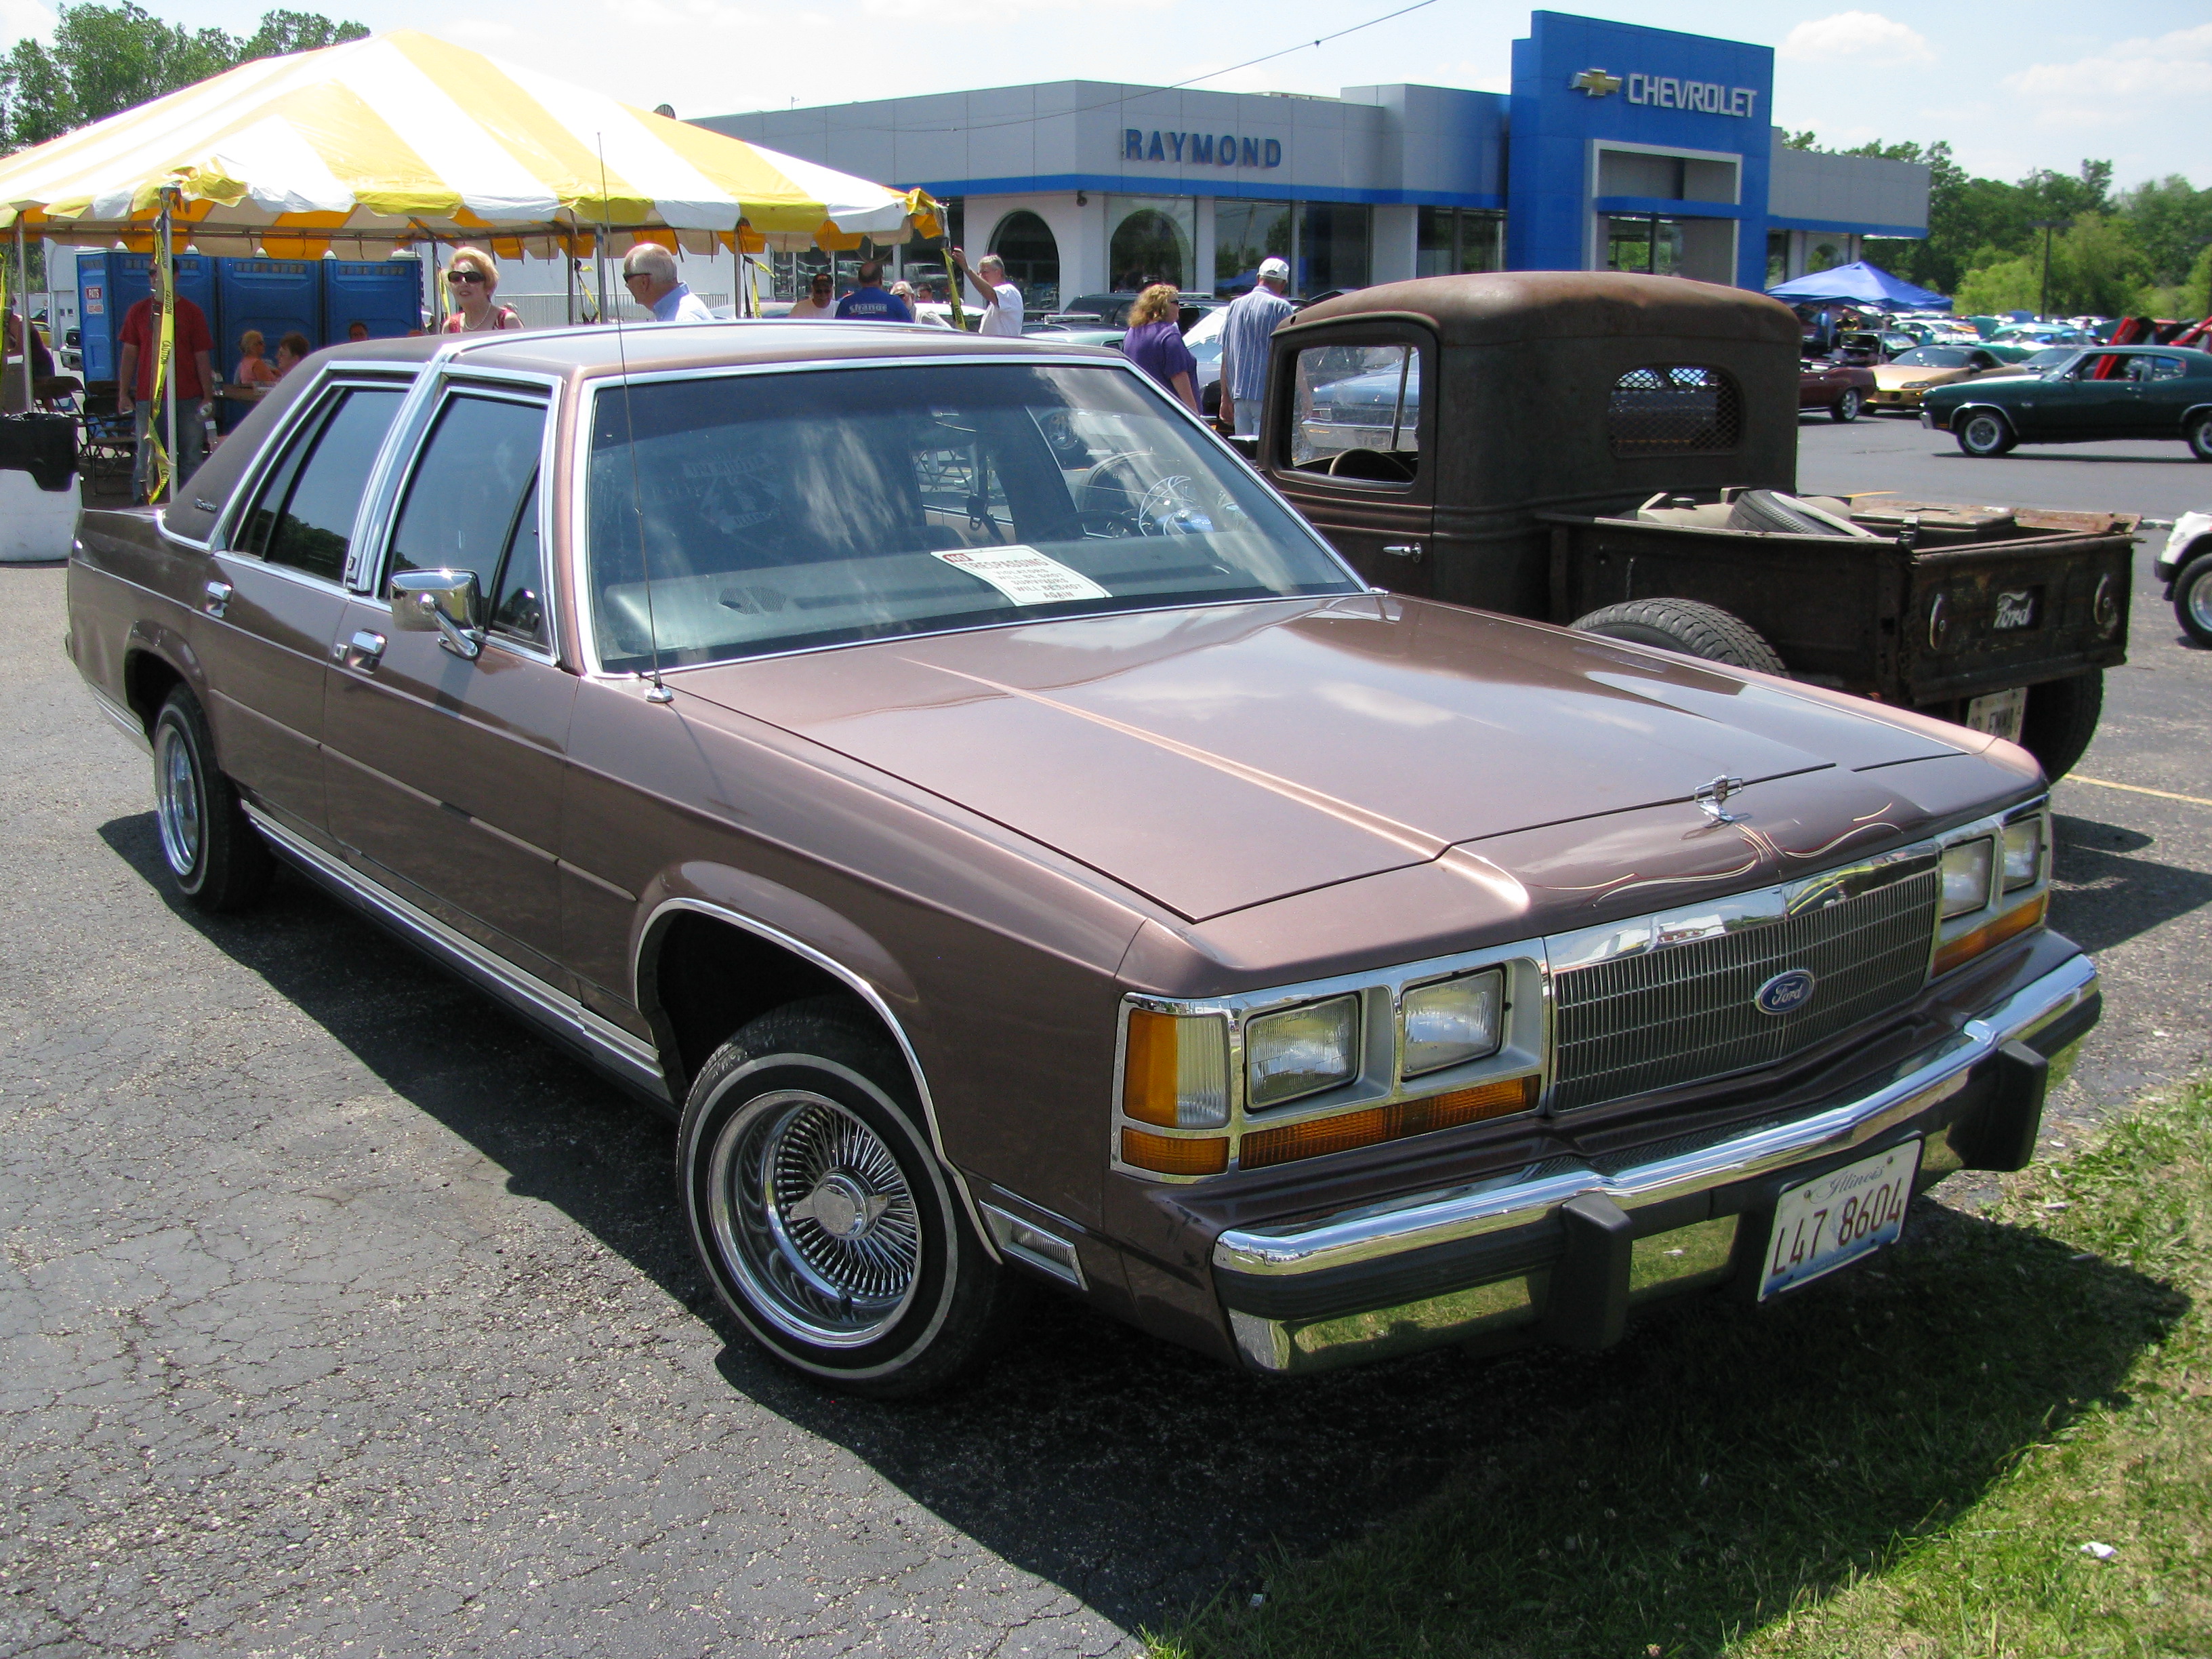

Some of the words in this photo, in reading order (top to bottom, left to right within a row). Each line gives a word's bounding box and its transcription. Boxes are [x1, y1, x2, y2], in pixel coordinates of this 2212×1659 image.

[1629, 73, 1757, 117] CHEVROLET
[1123, 129, 1281, 168] RAYMOND
[960, 558, 1050, 569] TRESPASSING
[1993, 591, 2034, 629] Ford
[1771, 981, 1803, 1005] Ford
[1809, 1165, 1885, 1204] Illinois
[1771, 1208, 1828, 1275] L47
[1837, 1177, 1902, 1247] 8604
